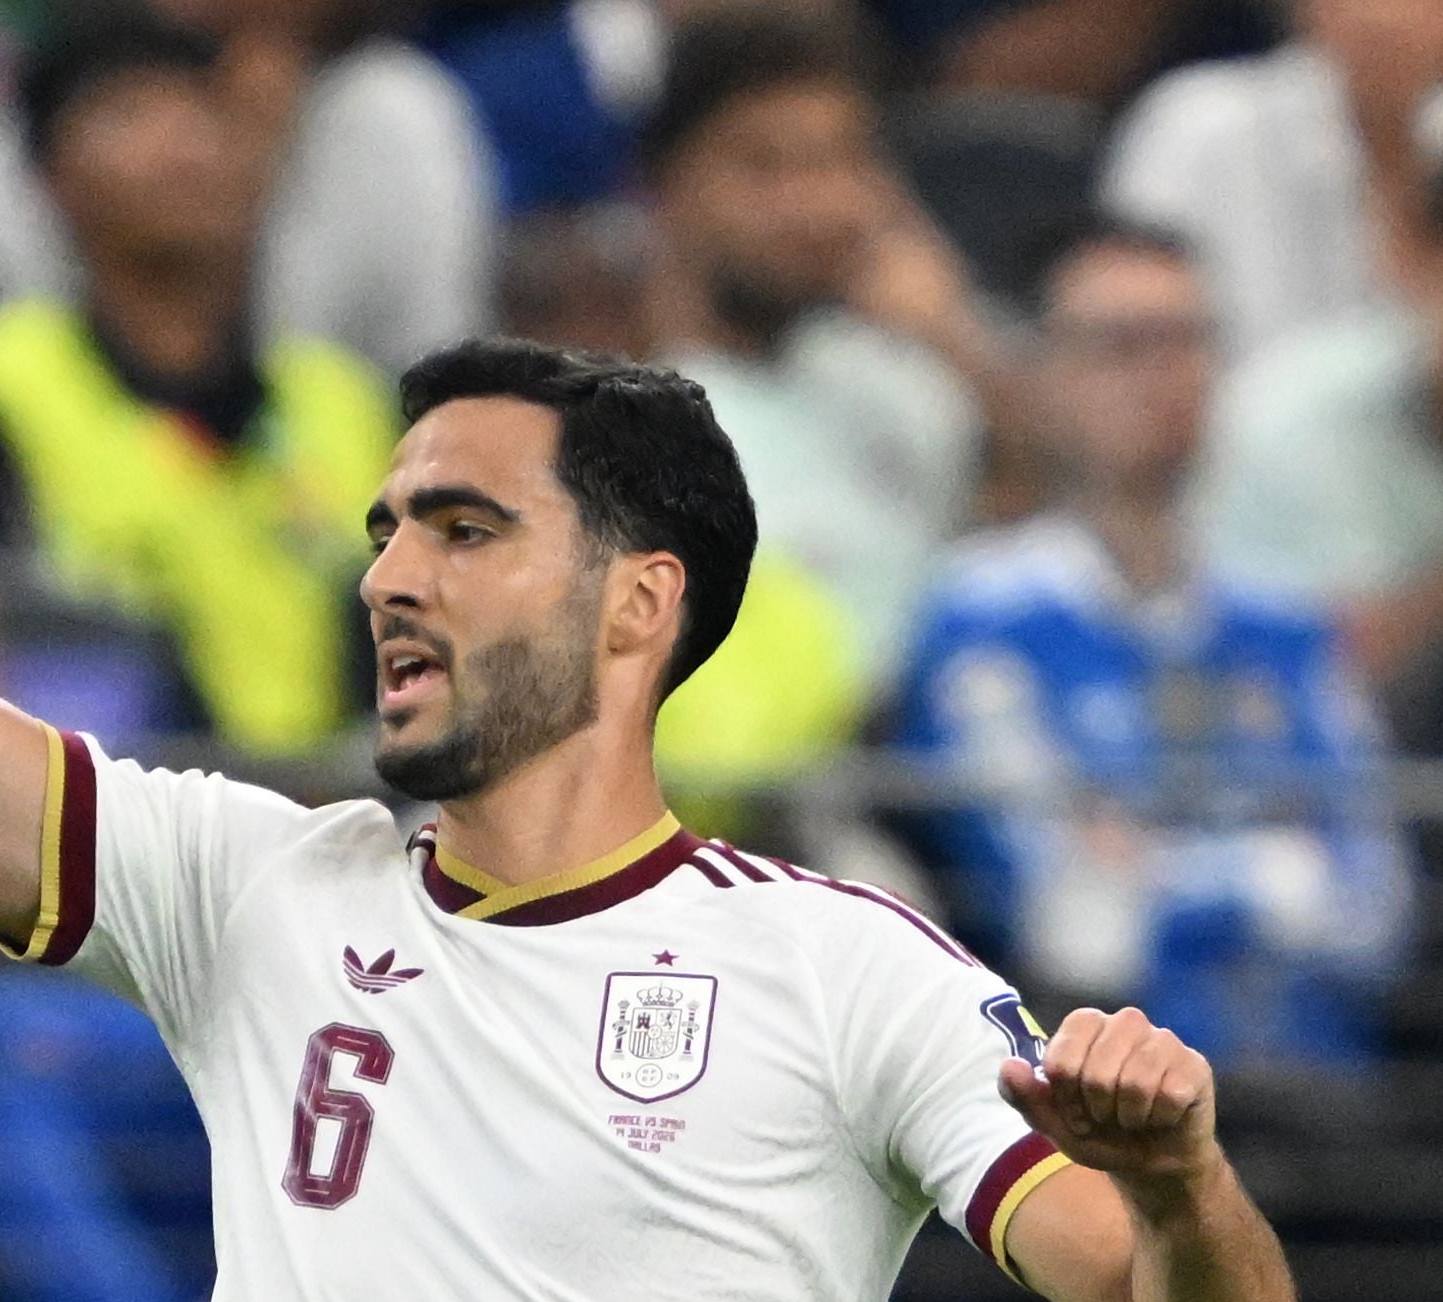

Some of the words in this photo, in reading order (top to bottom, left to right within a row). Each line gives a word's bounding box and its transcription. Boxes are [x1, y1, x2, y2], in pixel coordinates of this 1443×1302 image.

[281, 1021, 395, 1210] 6
[628, 1128, 649, 1139] JULY
[628, 1140, 661, 1154] DALLAS
